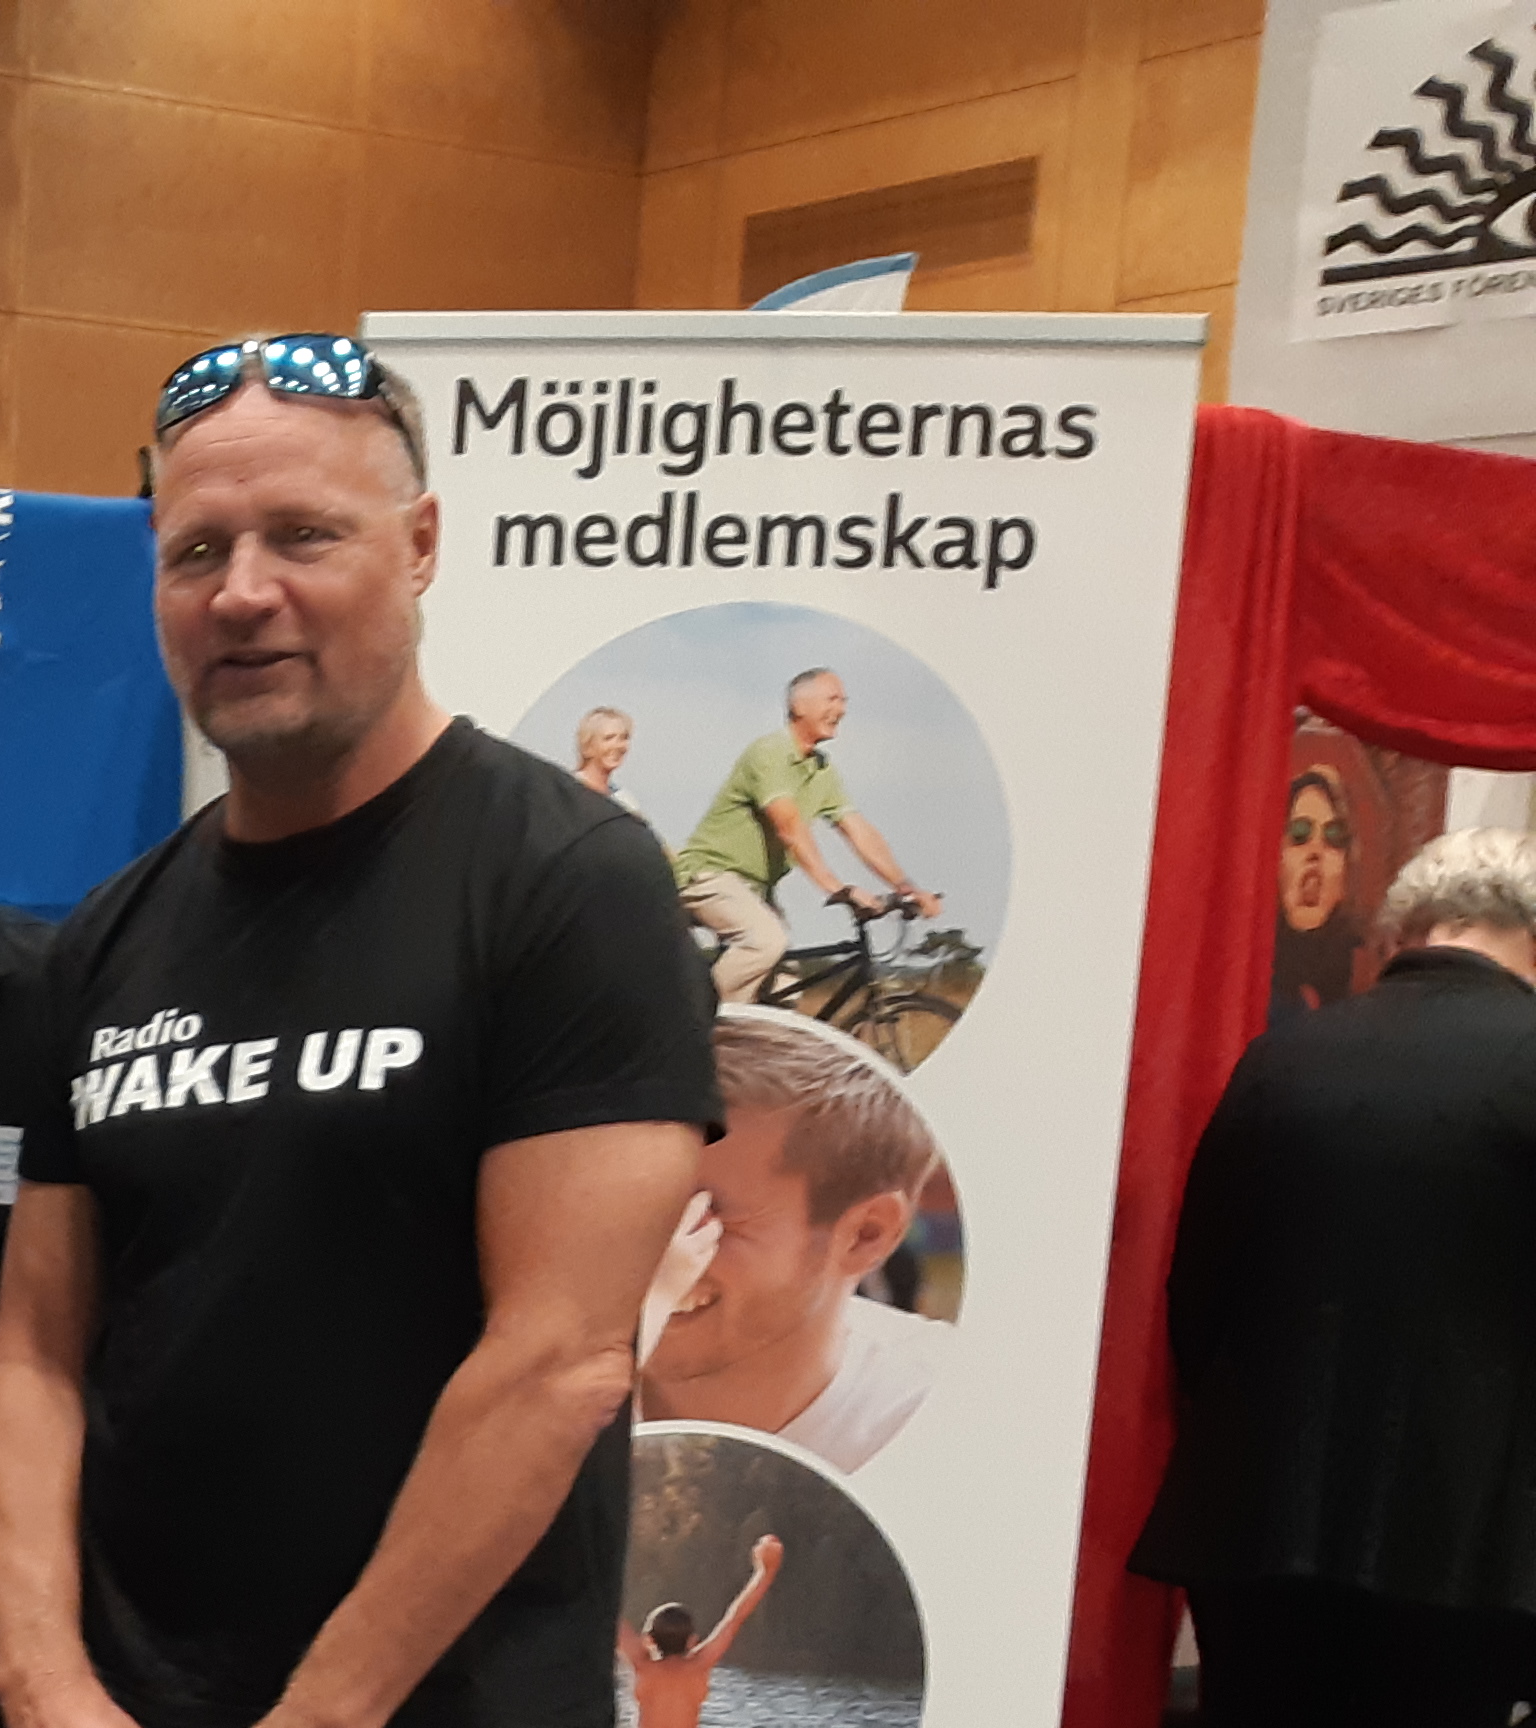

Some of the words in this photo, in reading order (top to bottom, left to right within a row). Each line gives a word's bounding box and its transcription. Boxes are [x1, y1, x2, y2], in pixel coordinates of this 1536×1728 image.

[451, 375, 1099, 481] Möjligheternas
[492, 489, 1037, 591] medlemskap
[89, 1007, 204, 1062] Radio
[296, 1026, 425, 1092] UP
